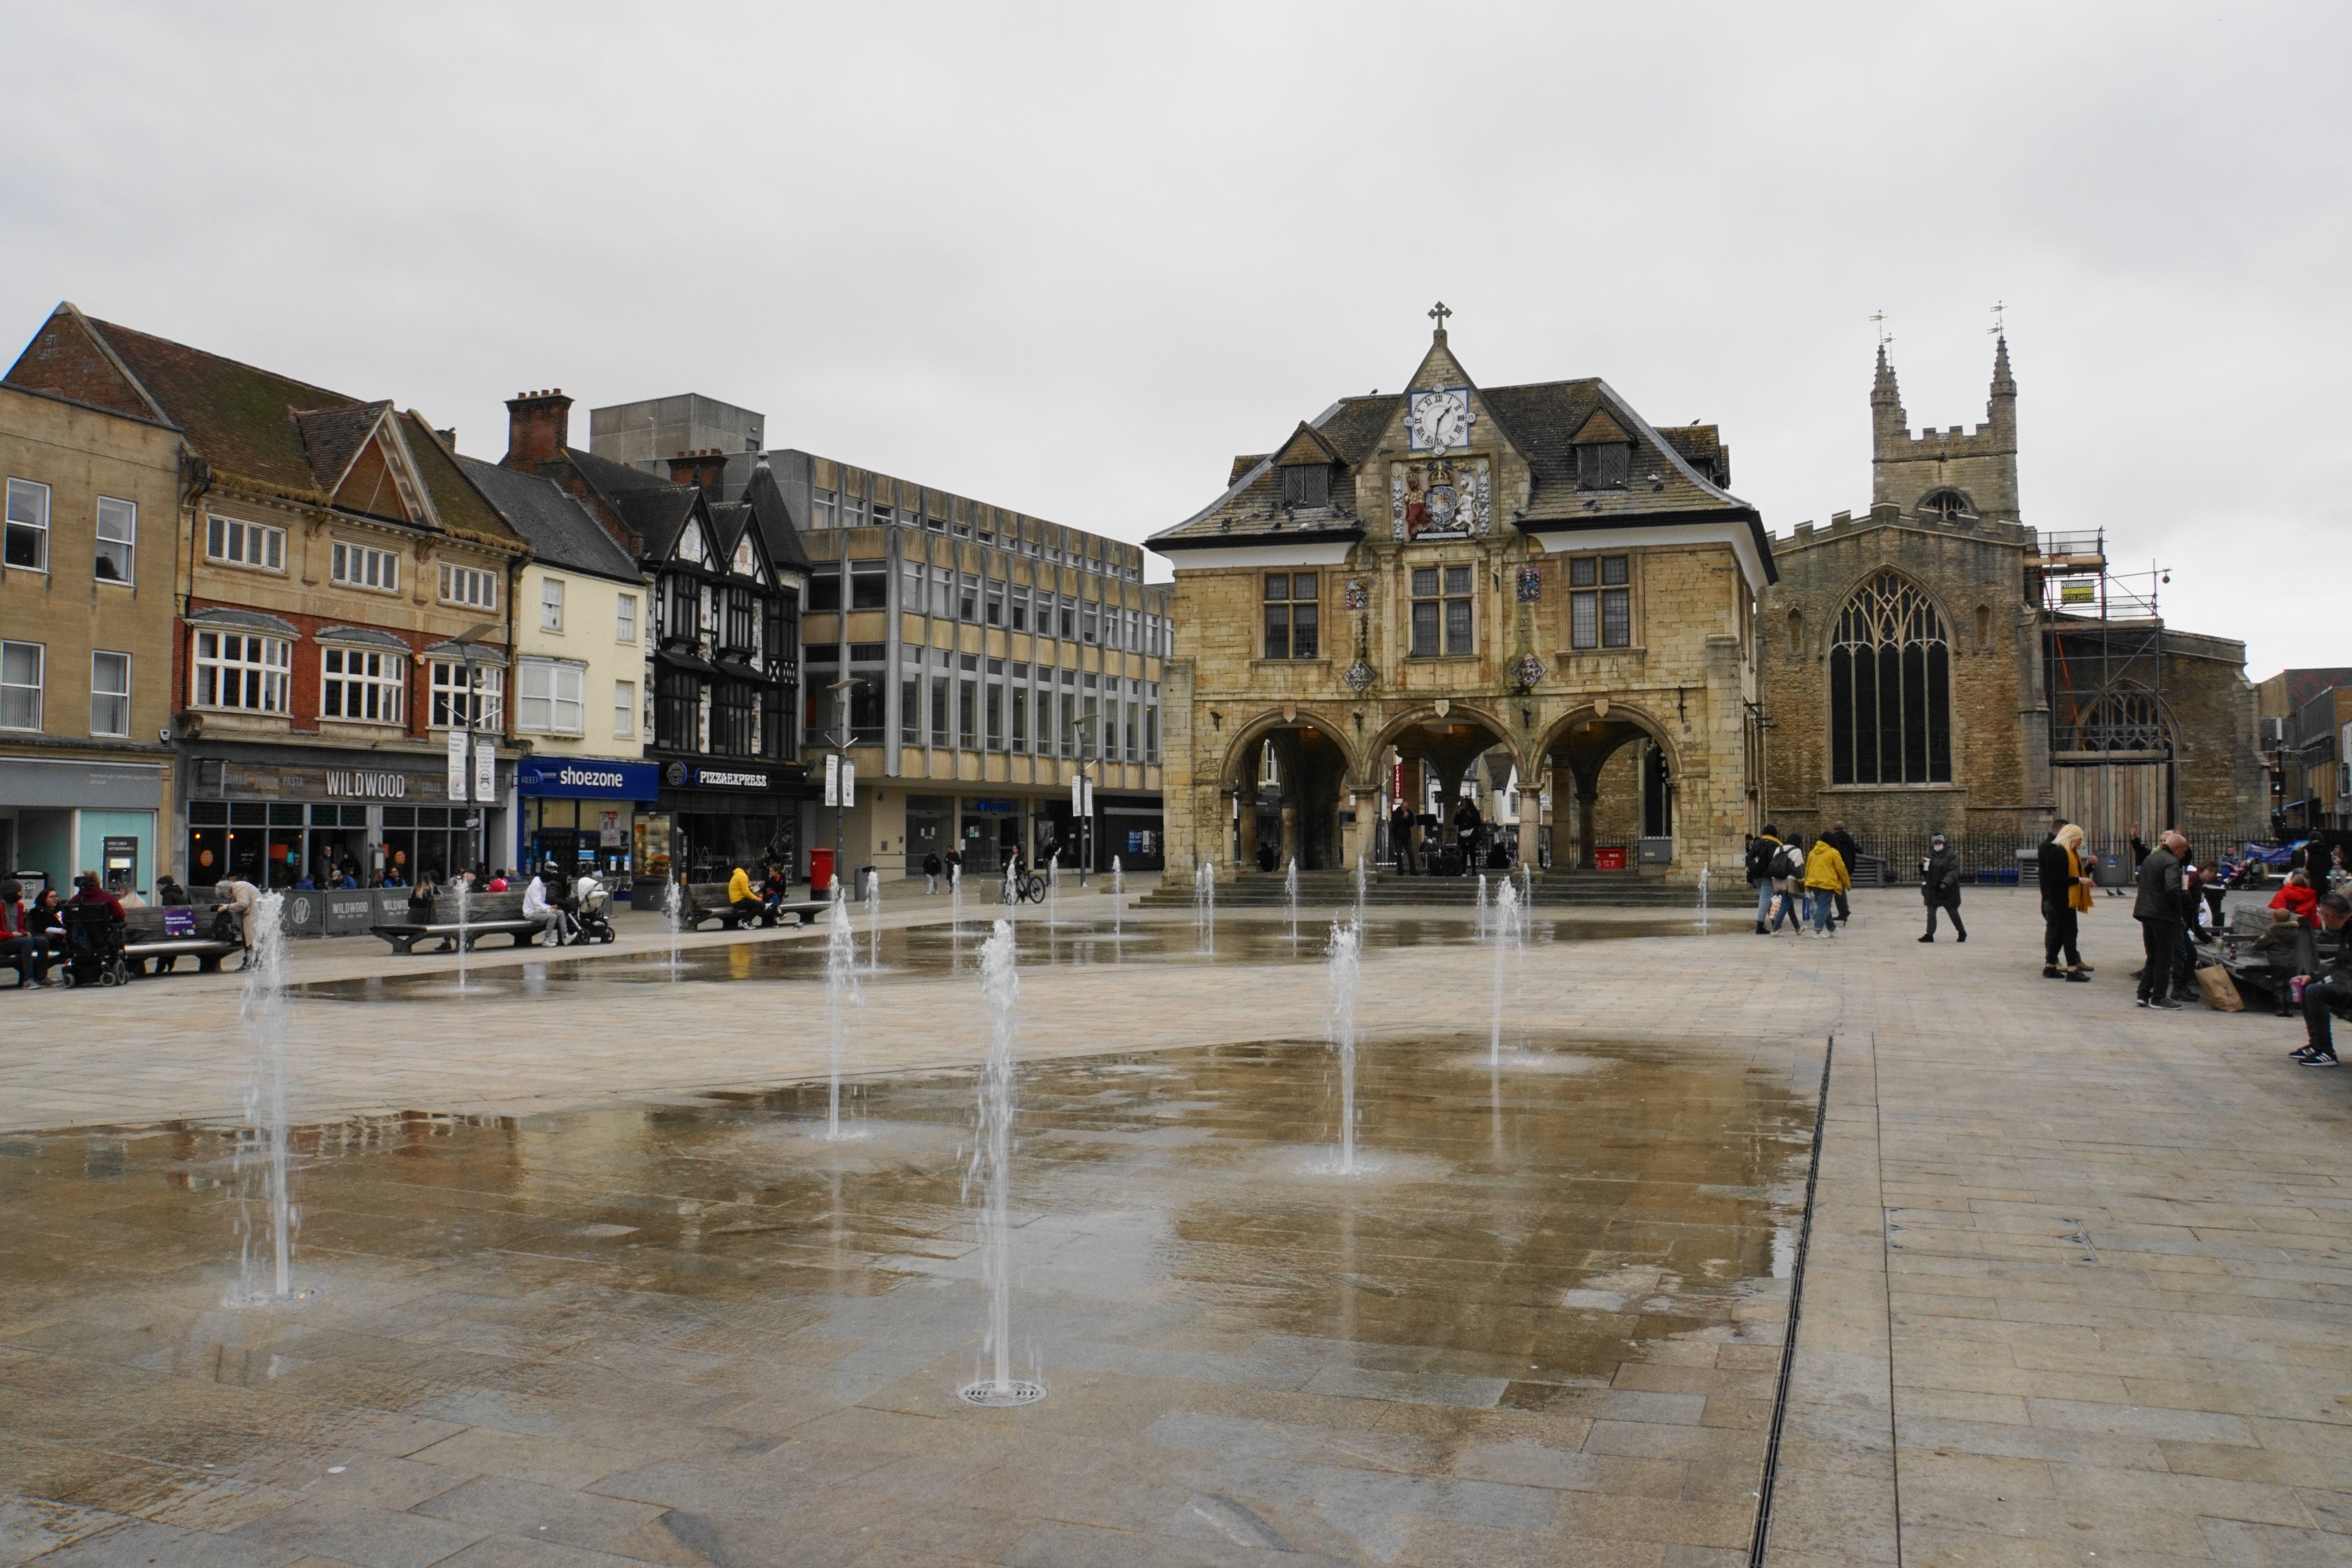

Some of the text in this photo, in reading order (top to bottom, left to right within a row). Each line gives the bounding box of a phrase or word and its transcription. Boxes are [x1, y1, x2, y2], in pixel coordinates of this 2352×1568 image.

[1424, 398, 1433, 407] XI
[1417, 426, 1425, 438] VIII
[1454, 424, 1463, 434] IIII
[1425, 435, 1434, 445] VII
[283, 776, 304, 787] PASTA
[561, 766, 622, 787] shoezone
[700, 771, 767, 786] PIZZAEXPRESS
[327, 771, 405, 798] WILDWOOD
[422, 782, 441, 792] GRILLS
[333, 902, 368, 914] WILDWOOD
[383, 900, 408, 911] WILDWO
